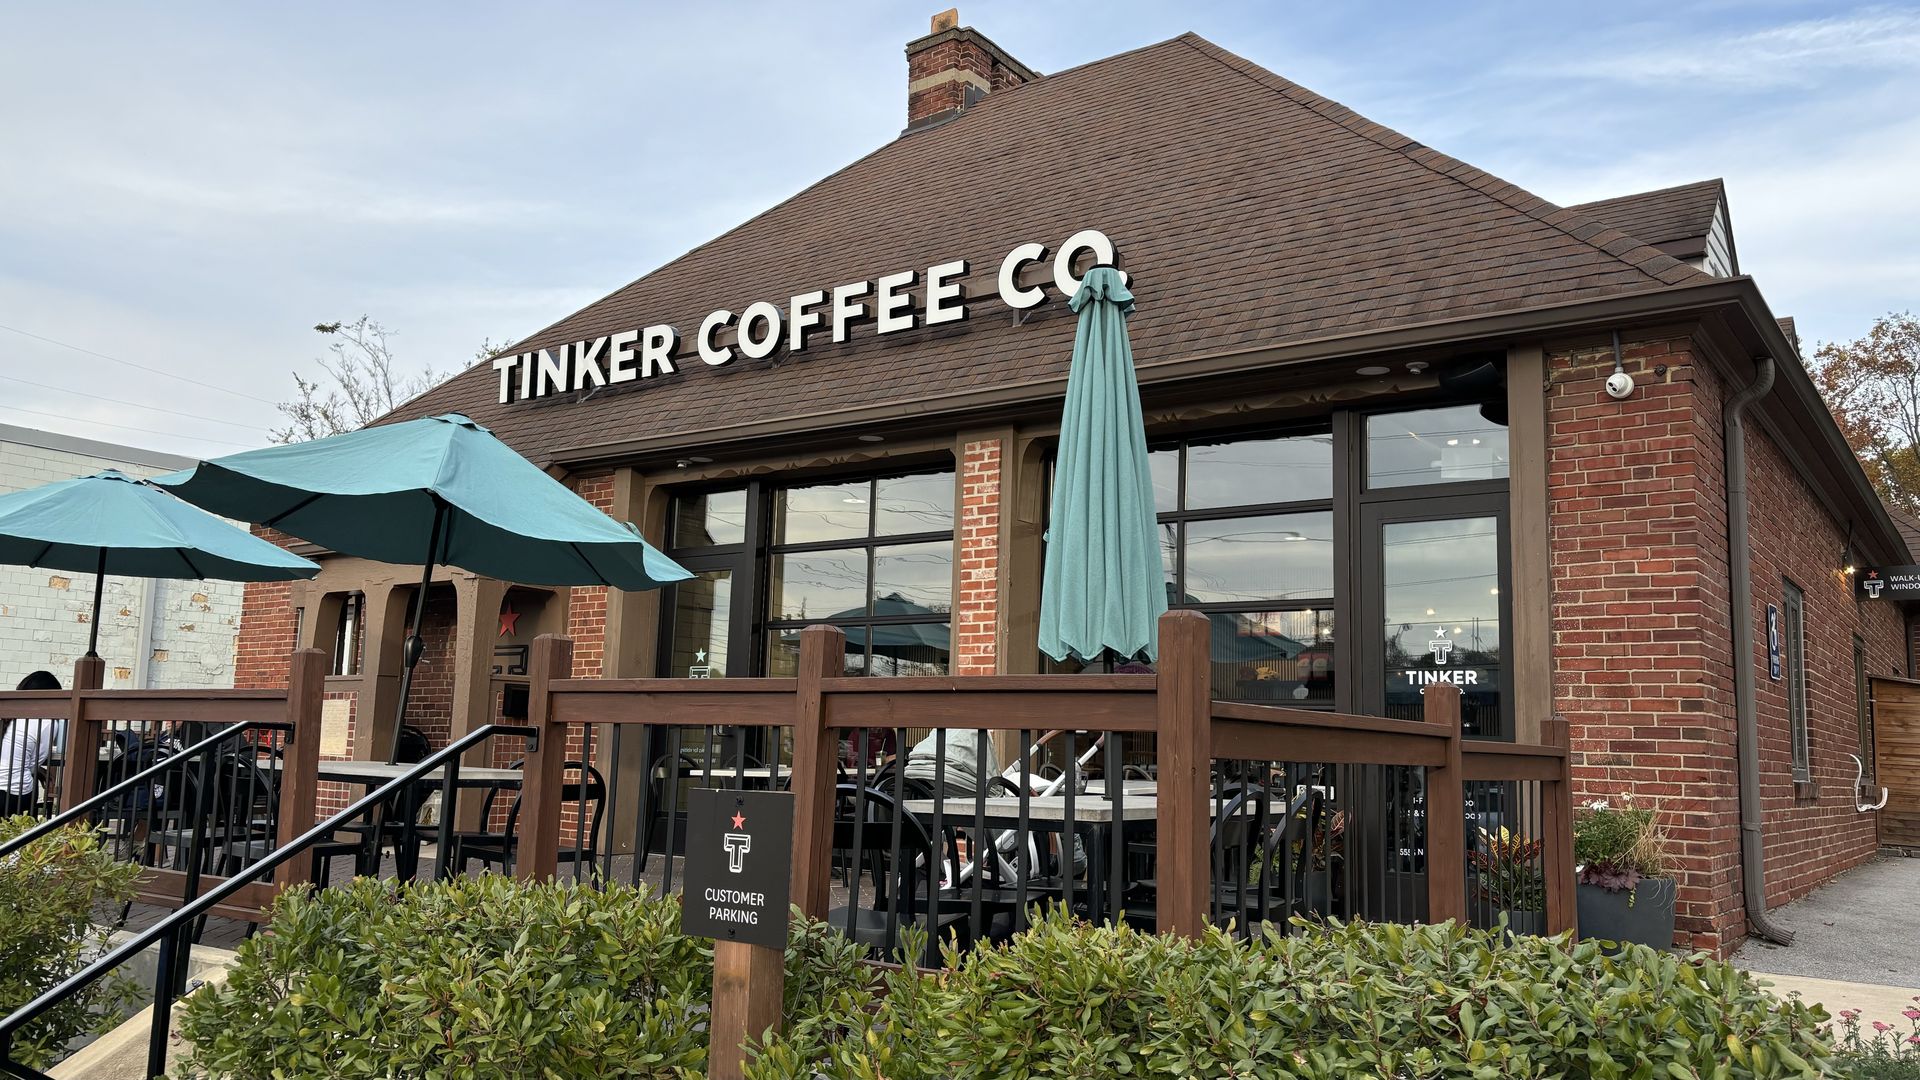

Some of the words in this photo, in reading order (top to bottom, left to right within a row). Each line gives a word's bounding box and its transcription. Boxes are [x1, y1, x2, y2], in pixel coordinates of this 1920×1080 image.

[491, 323, 679, 404] TINKER
[698, 259, 967, 366] COFFEE
[998, 229, 1128, 308] CO.
[1405, 670, 1478, 685] TINKER
[704, 887, 765, 907] CUSTOMER
[709, 906, 759, 925] PARKING
